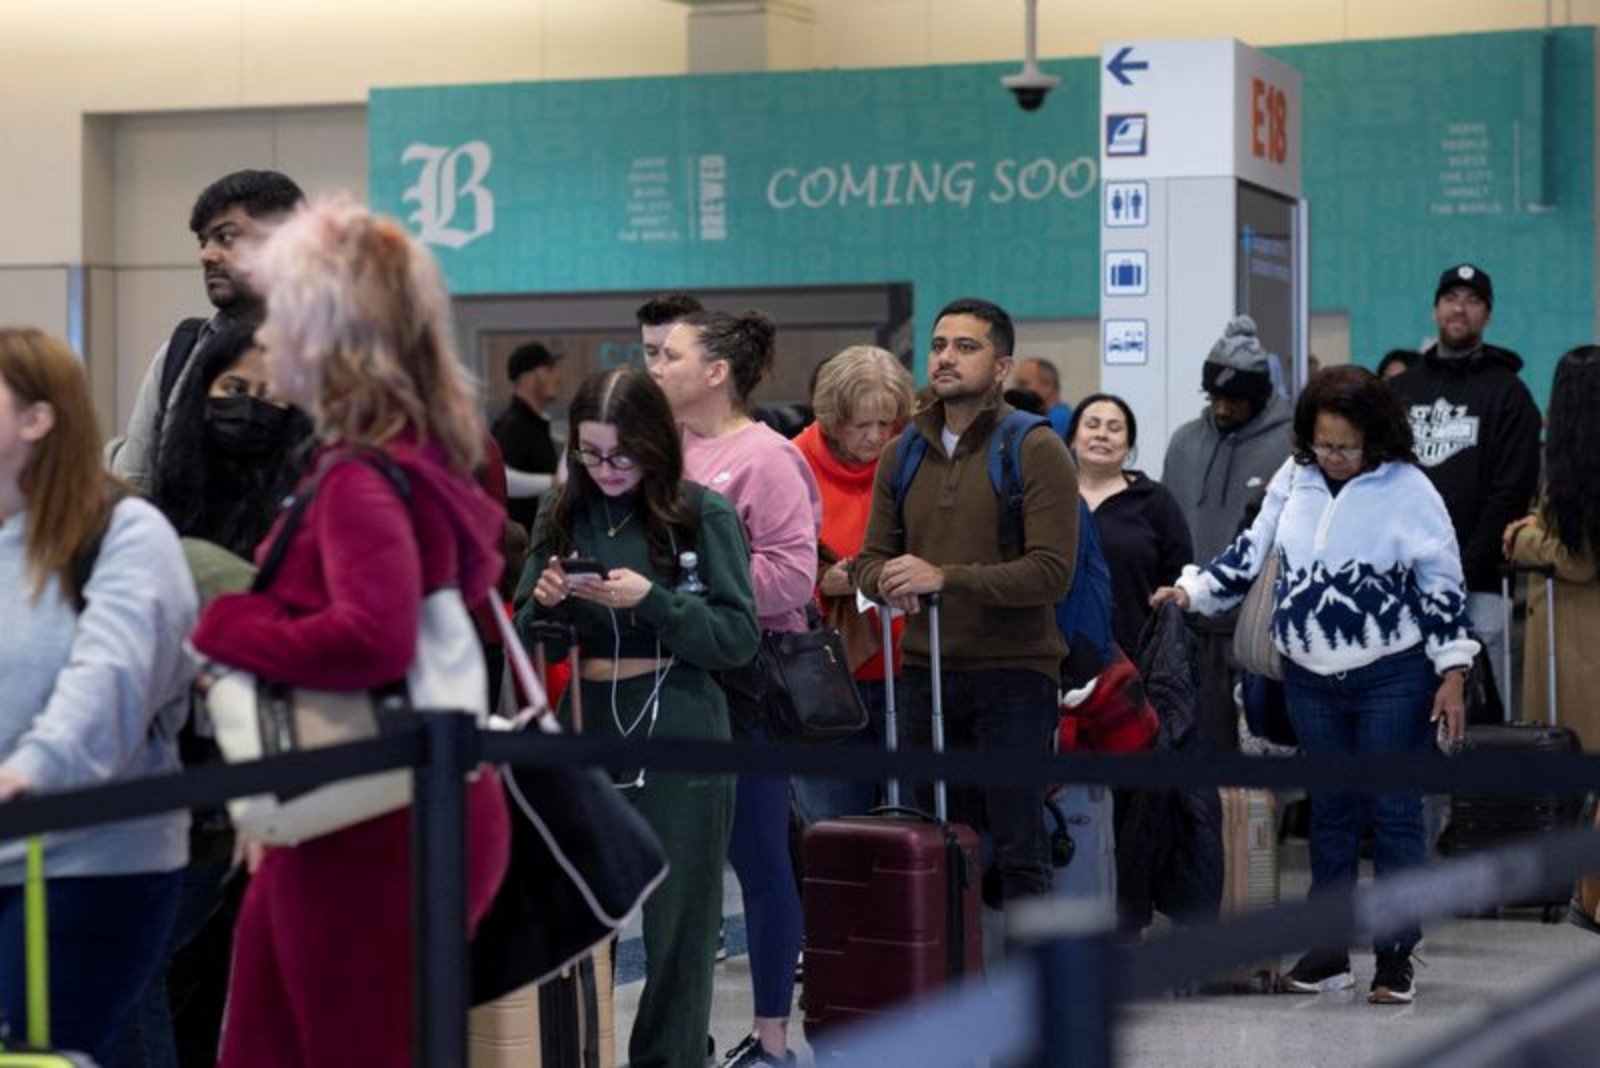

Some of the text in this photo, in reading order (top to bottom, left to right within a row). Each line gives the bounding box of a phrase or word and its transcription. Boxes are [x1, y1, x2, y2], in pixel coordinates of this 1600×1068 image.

[1252, 77, 1288, 165] E18
[402, 140, 494, 249] B
[699, 155, 727, 241] BREWED
[766, 156, 1098, 210] COMING SOO
